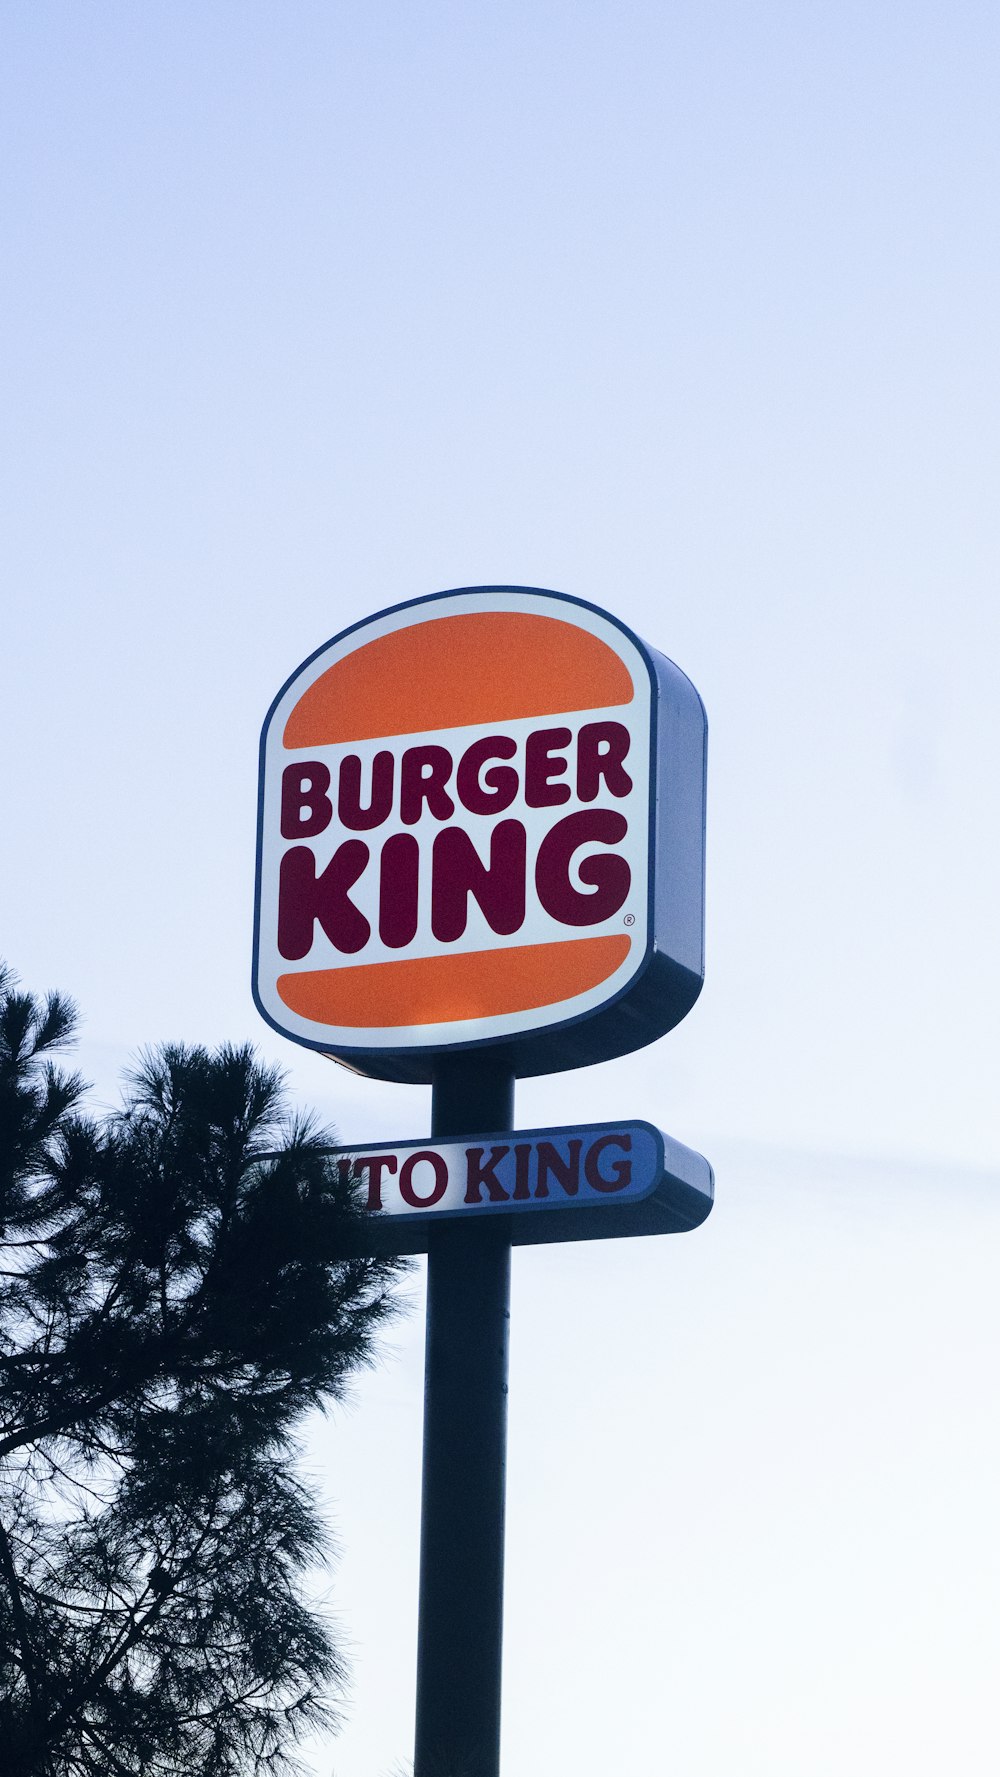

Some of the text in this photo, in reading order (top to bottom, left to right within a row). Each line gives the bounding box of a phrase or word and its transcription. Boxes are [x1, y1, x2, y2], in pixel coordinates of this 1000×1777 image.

[281, 721, 633, 840] BURGER
[278, 809, 633, 961] KING
[322, 1134, 632, 1211] TO KING
